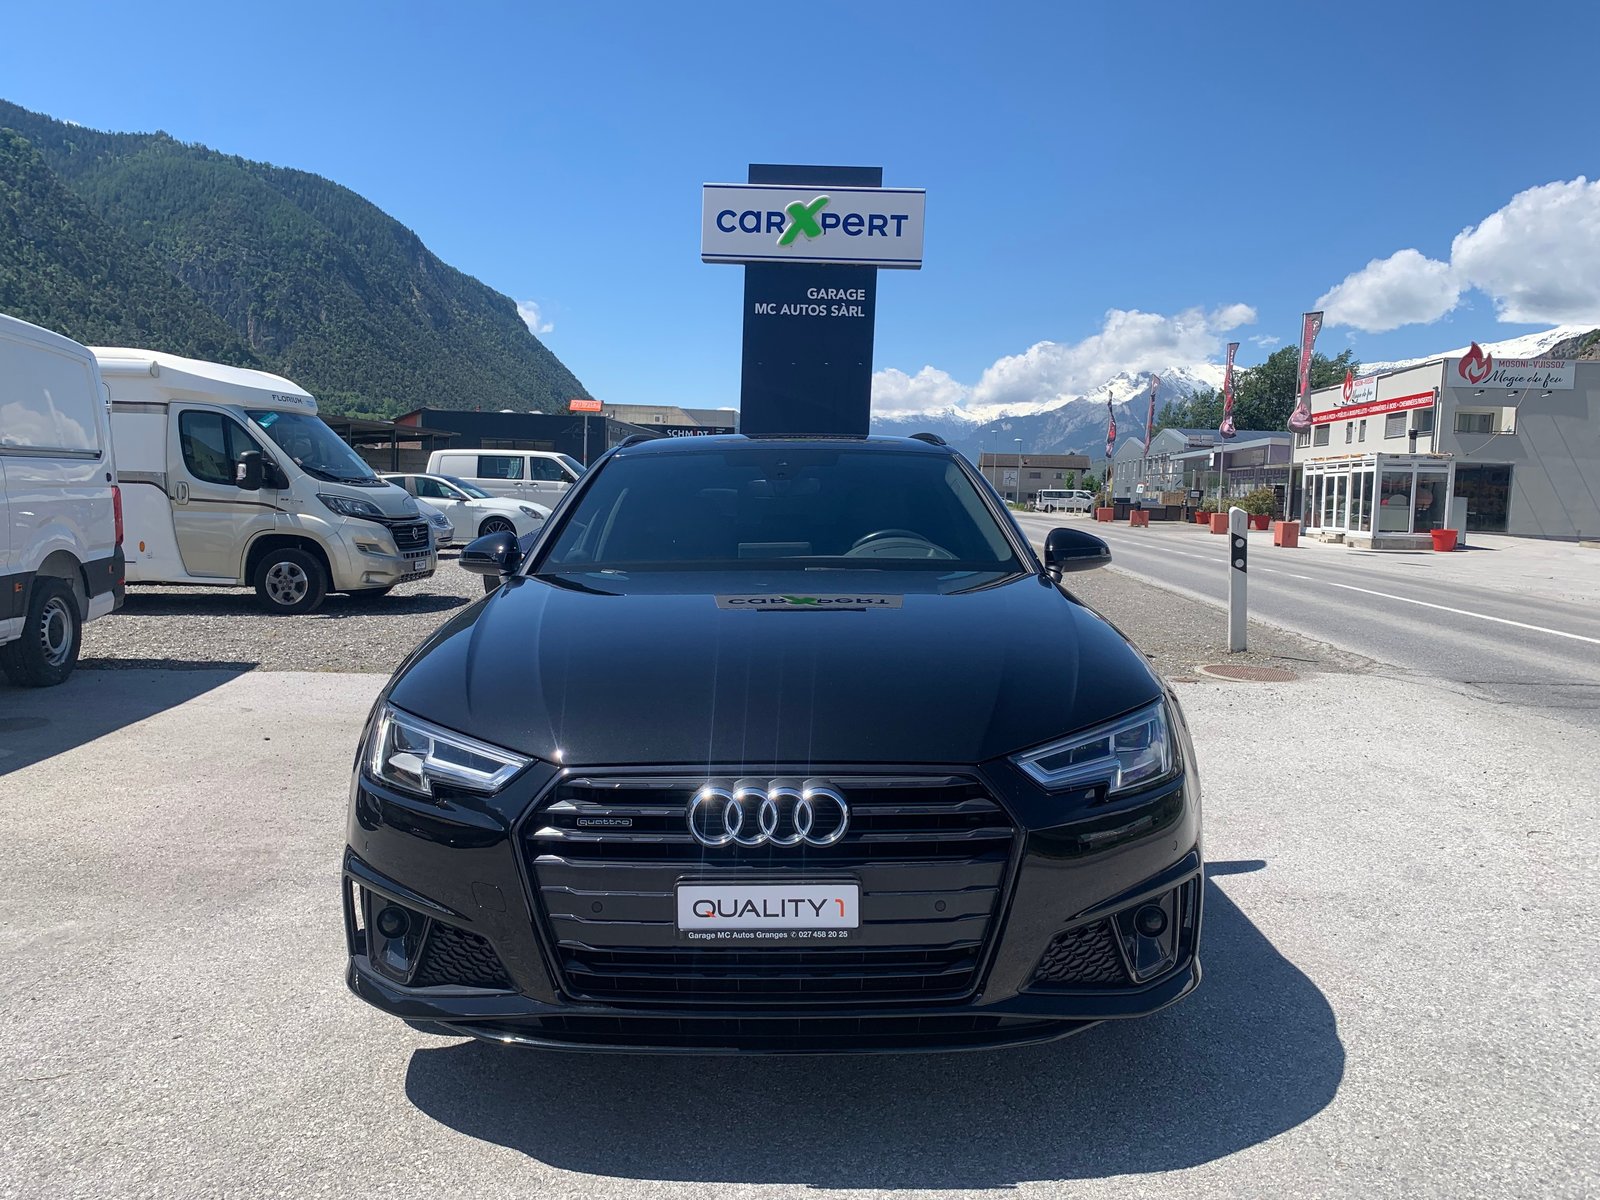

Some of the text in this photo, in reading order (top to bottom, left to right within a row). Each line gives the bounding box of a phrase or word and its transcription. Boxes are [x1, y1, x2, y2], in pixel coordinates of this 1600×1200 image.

[807, 288, 866, 301] GARAGE
[754, 302, 866, 317] MC AUTOS SÀRL
[1483, 369, 1564, 388] Magie du feu
[272, 394, 303, 404] FLORIUM
[692, 899, 845, 918] QUALITY 1
[688, 931, 716, 940] Garage
[717, 931, 731, 939] MC
[732, 931, 755, 939] Autos
[756, 931, 788, 940] Granges
